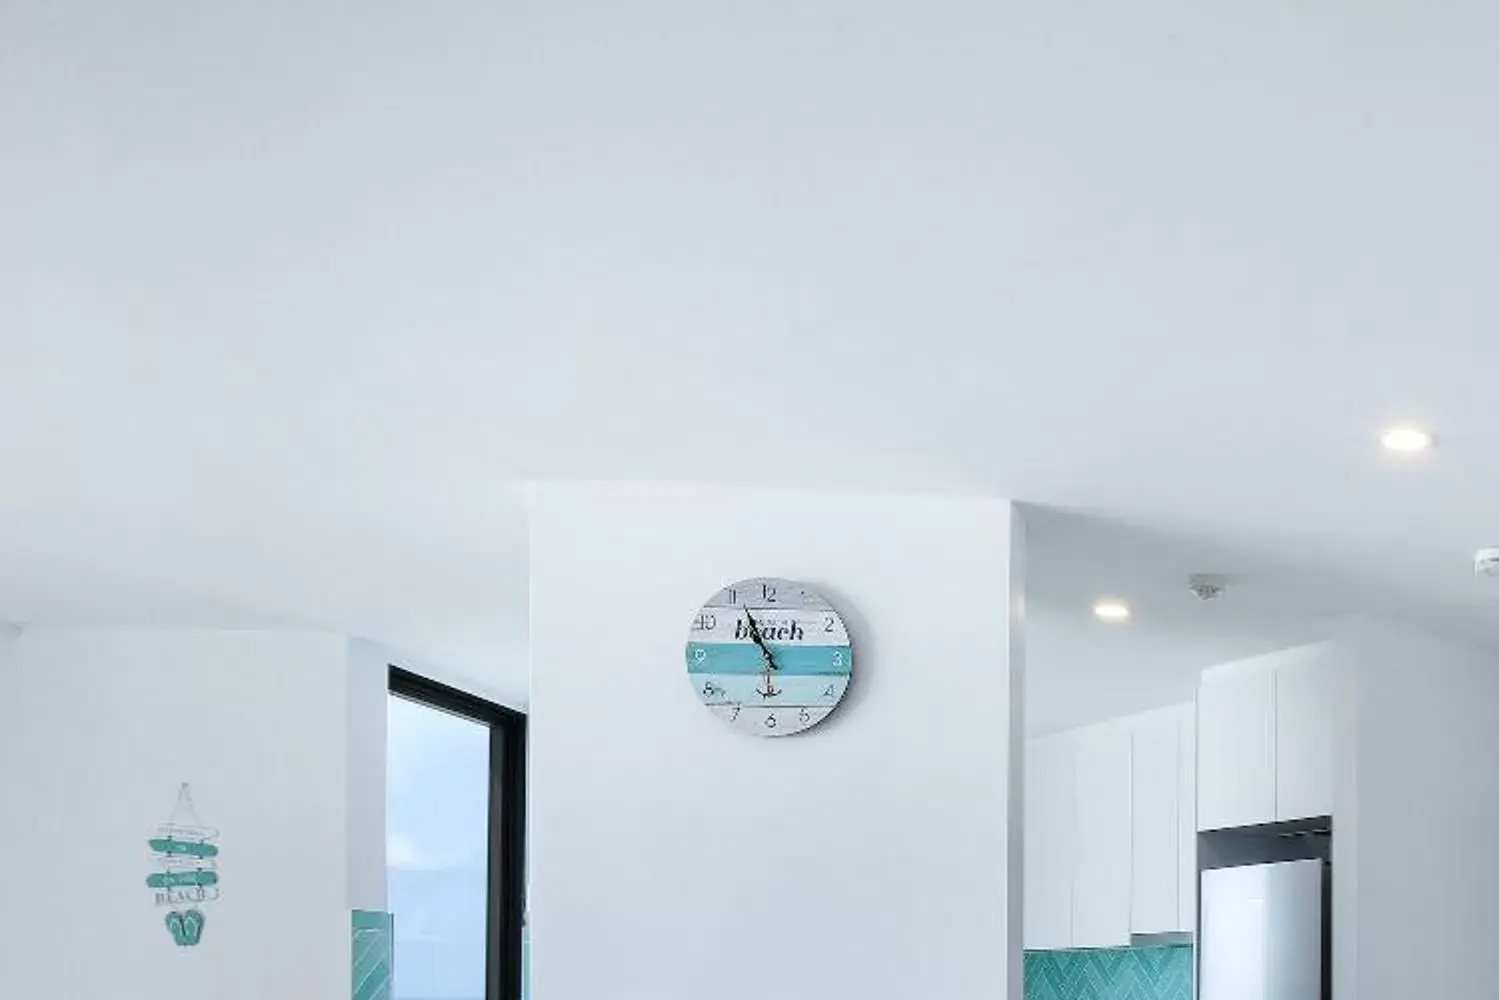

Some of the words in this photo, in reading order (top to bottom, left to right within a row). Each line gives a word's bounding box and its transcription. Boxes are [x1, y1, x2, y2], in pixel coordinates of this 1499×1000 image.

[762, 584, 777, 602] 12
[824, 617, 834, 632] 2
[832, 651, 843, 666] 3
[764, 714, 777, 728] 6
